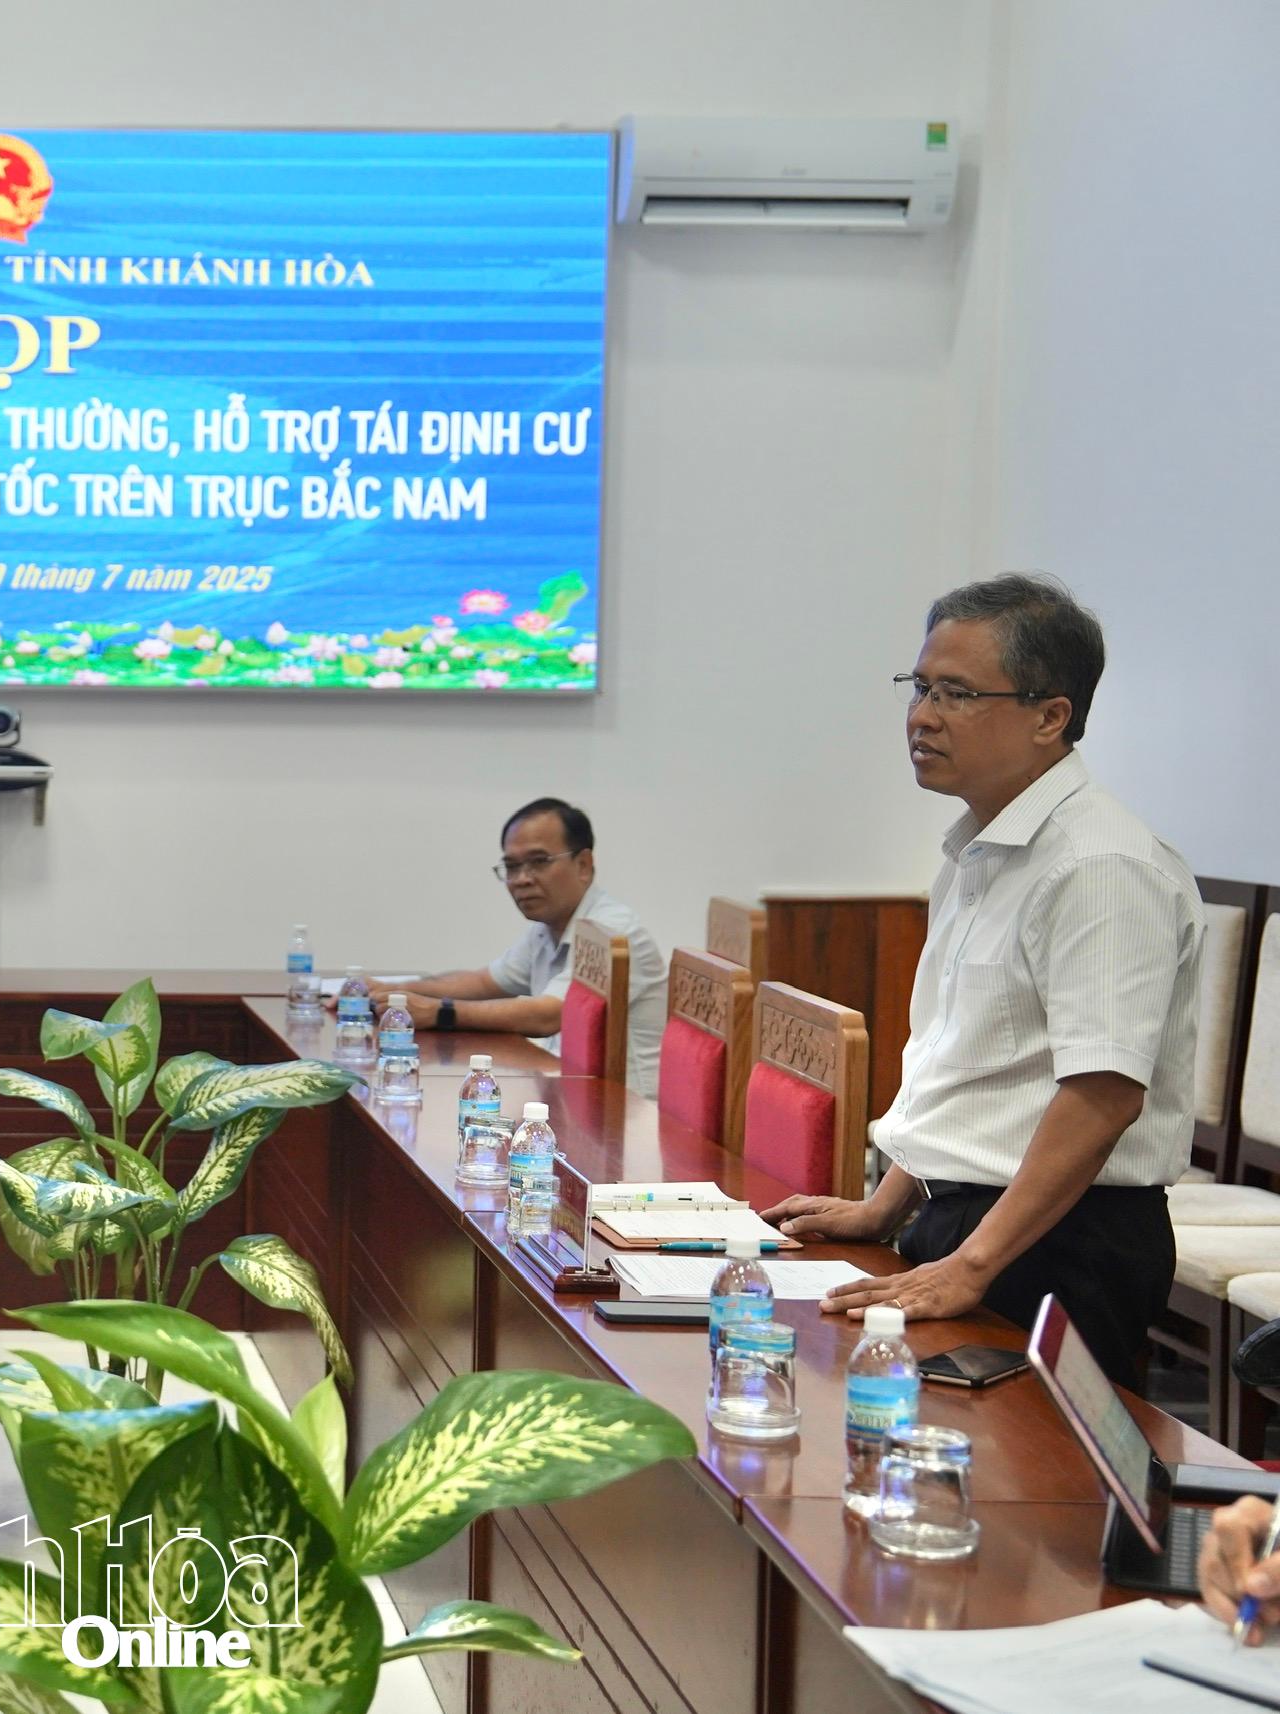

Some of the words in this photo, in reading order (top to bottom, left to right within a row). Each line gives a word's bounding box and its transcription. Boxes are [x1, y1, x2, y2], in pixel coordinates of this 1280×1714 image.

[122, 253, 269, 285] KHÁNH
[286, 254, 373, 286] HÒA
[4, 398, 180, 458] THƯỜNG,
[195, 394, 249, 452] HỖ
[261, 405, 341, 461] TRỢ
[350, 401, 407, 453] TÁI
[420, 412, 519, 462] ĐỊNH
[534, 408, 591, 455] CƯ
[69, 465, 173, 516] TRÊN
[185, 475, 289, 526] TRỤC
[302, 457, 380, 519] BẮC
[394, 478, 486, 519] NAM
[11, 564, 95, 593] tháng
[102, 564, 123, 589] 7
[126, 565, 192, 590] năm
[198, 566, 273, 592] 2025
